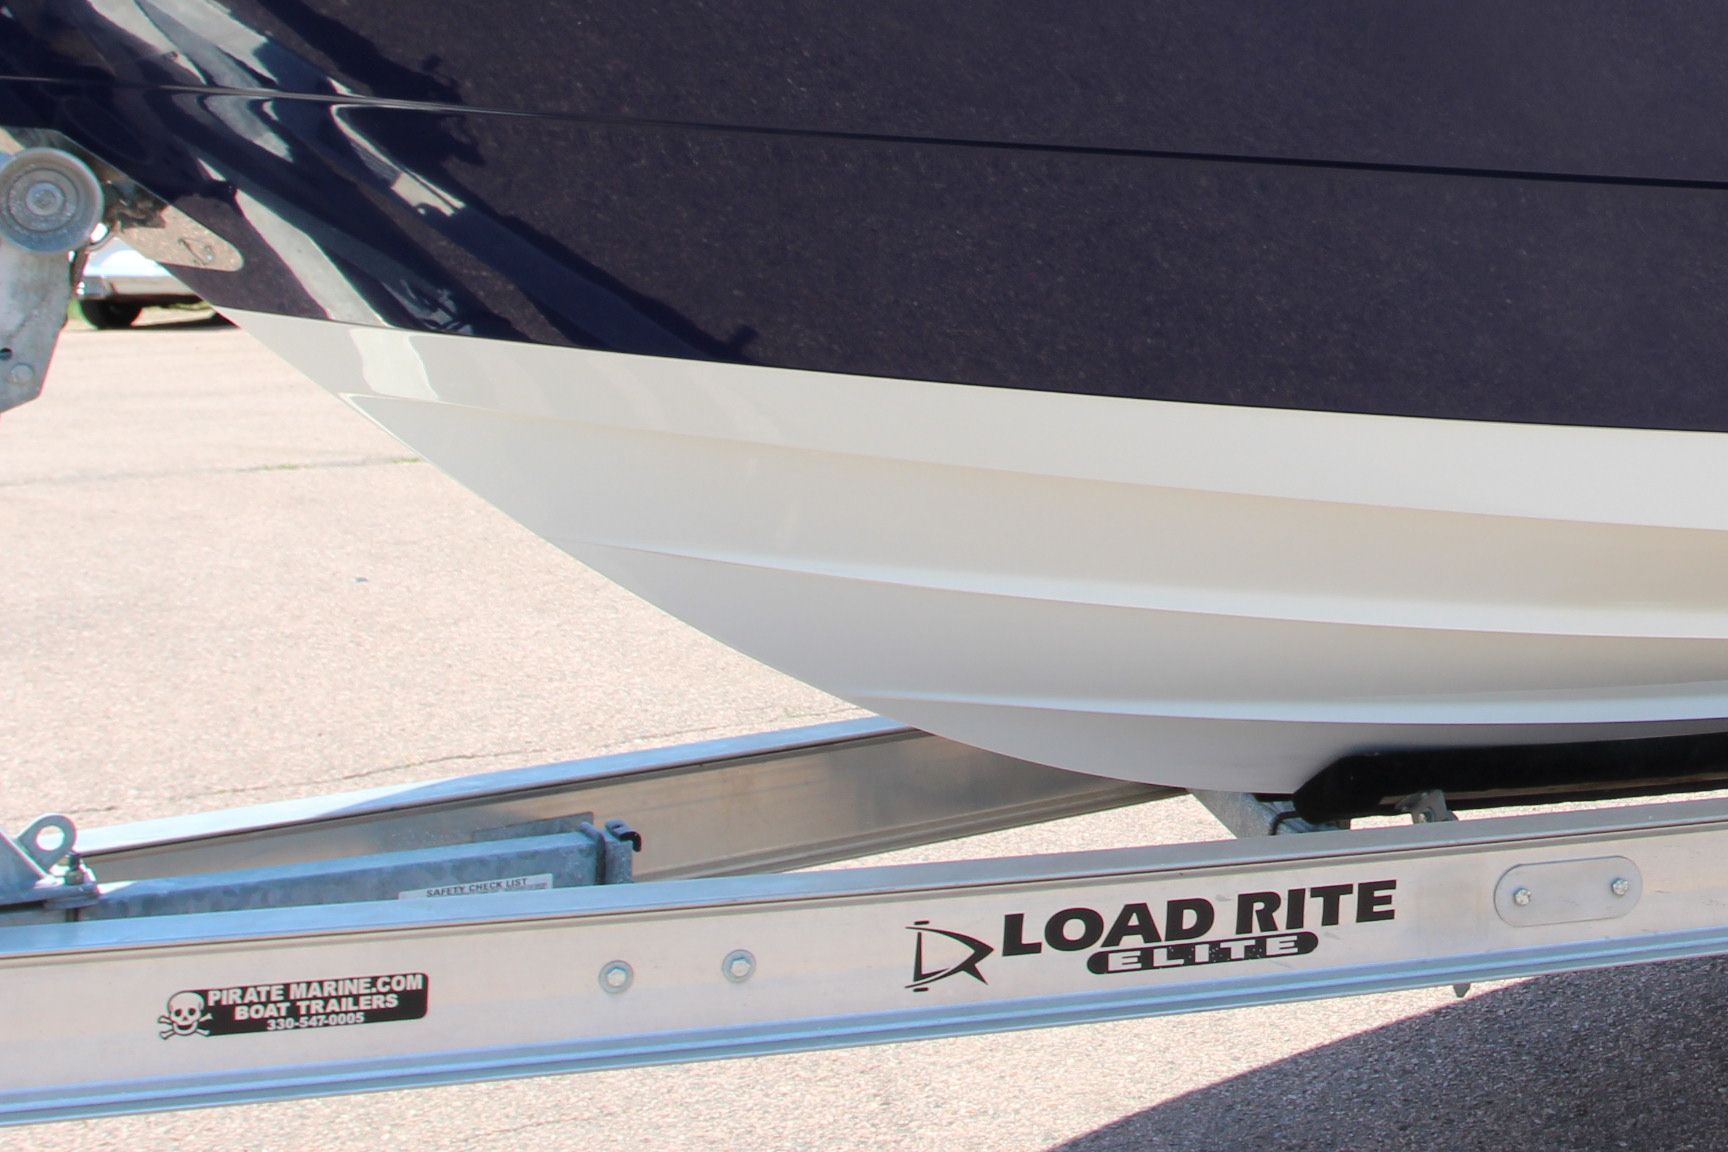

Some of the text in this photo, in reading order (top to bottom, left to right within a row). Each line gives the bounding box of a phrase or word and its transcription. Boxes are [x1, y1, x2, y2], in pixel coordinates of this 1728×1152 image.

[426, 886, 464, 897] SAFETY
[469, 881, 502, 892] CHECK
[505, 878, 527, 888] LIST
[1002, 879, 1397, 957] LOAD RITE
[1107, 936, 1298, 971] ELITE
[207, 974, 423, 1006] PIRATE MARINE.COM
[234, 993, 399, 1020] BOAT TRAILERS
[267, 1012, 365, 1031] 330-547-0005
